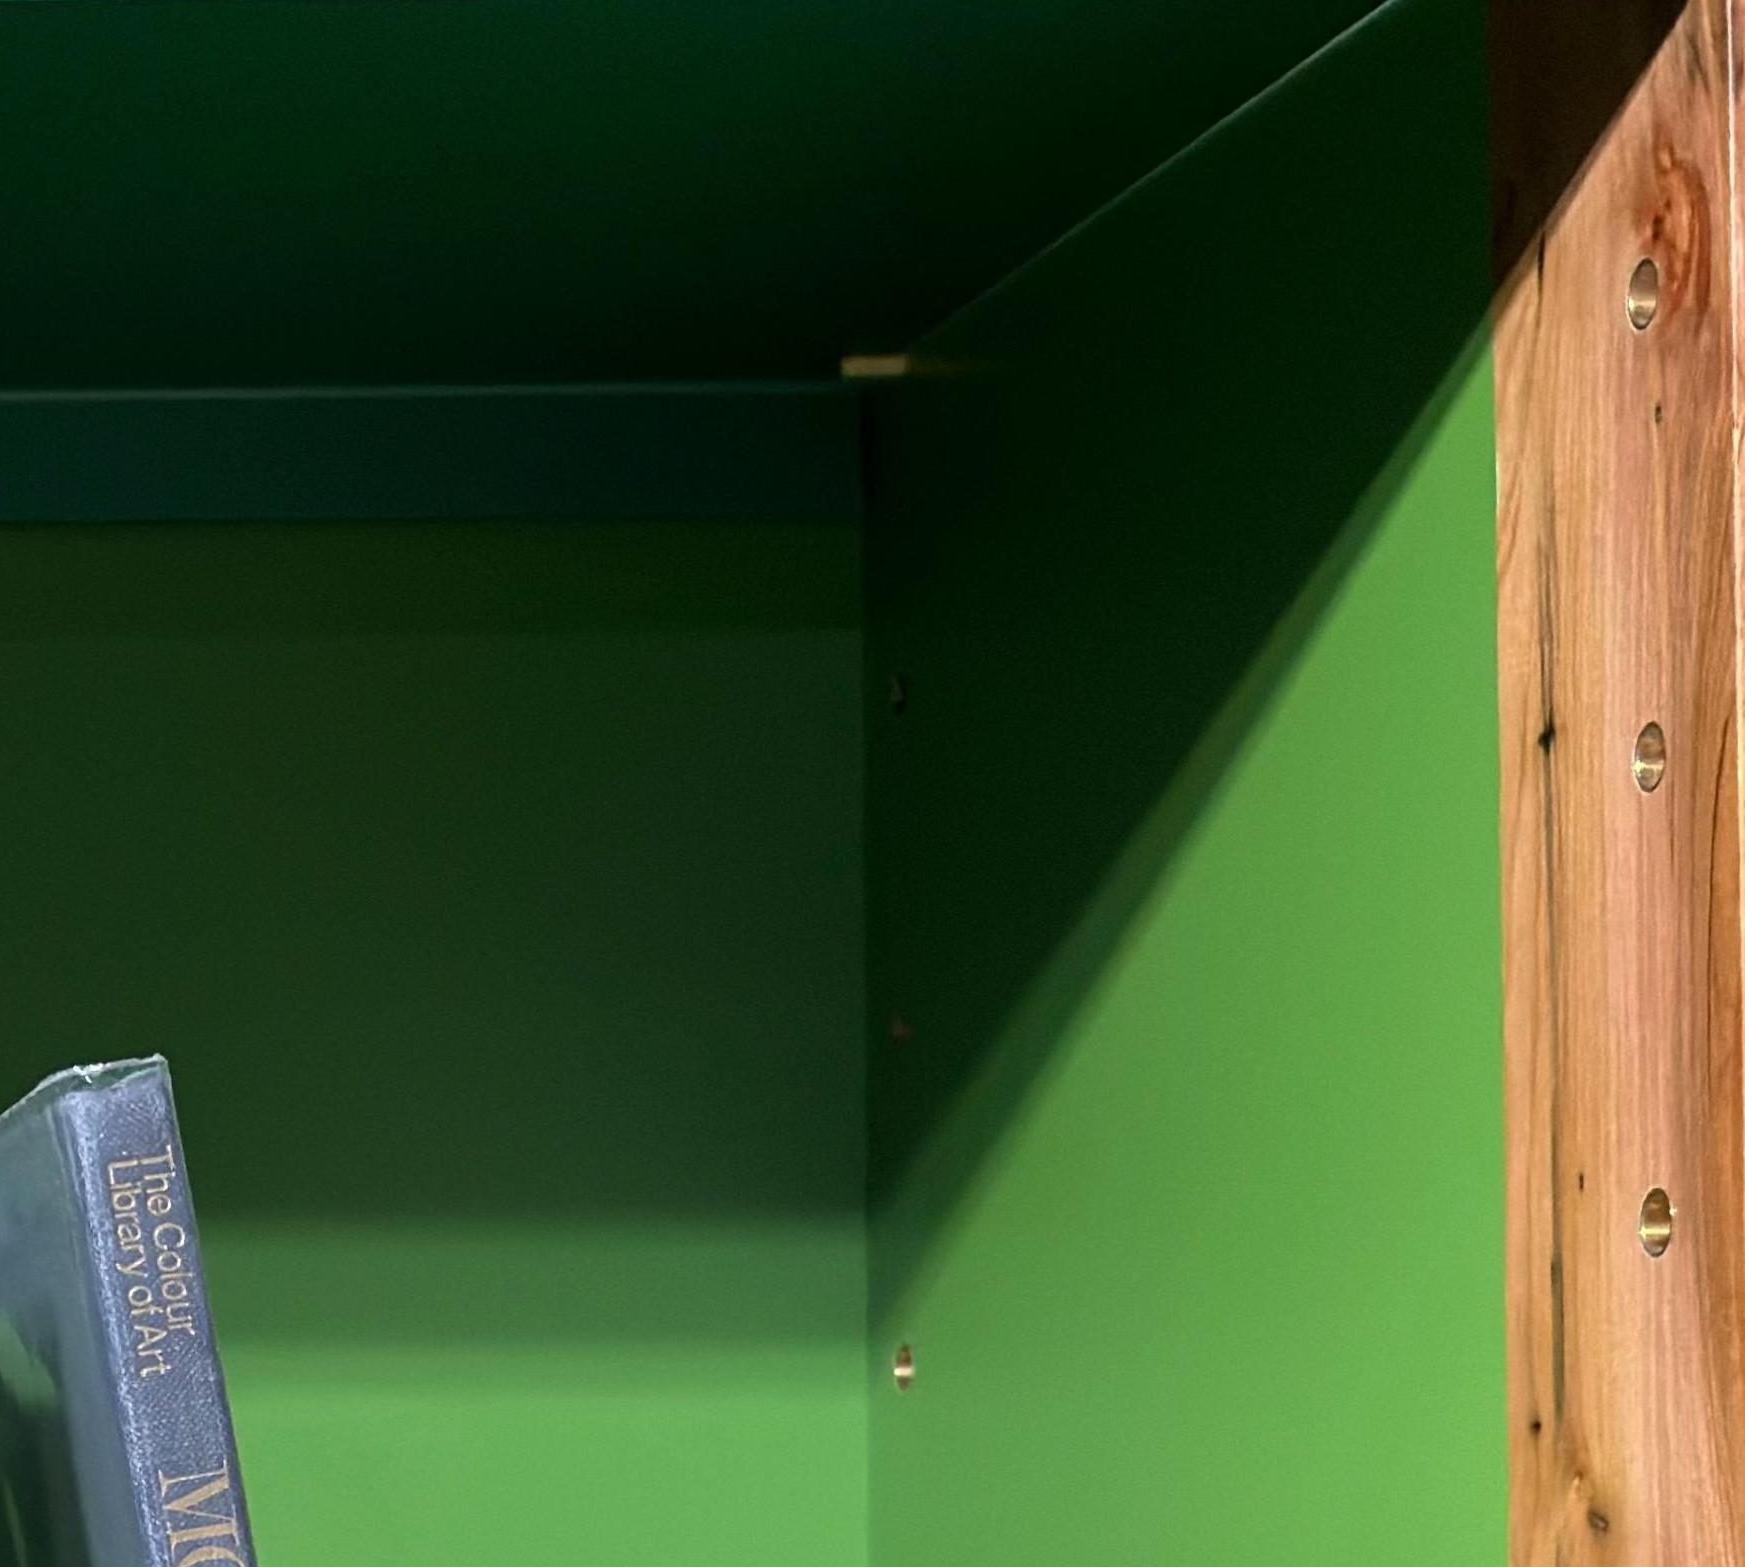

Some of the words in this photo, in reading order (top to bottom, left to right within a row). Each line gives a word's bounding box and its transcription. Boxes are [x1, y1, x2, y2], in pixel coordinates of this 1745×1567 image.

[106, 1158, 150, 1279] Library
[133, 1323, 172, 1379] Art
[152, 1221, 197, 1338] Colour
